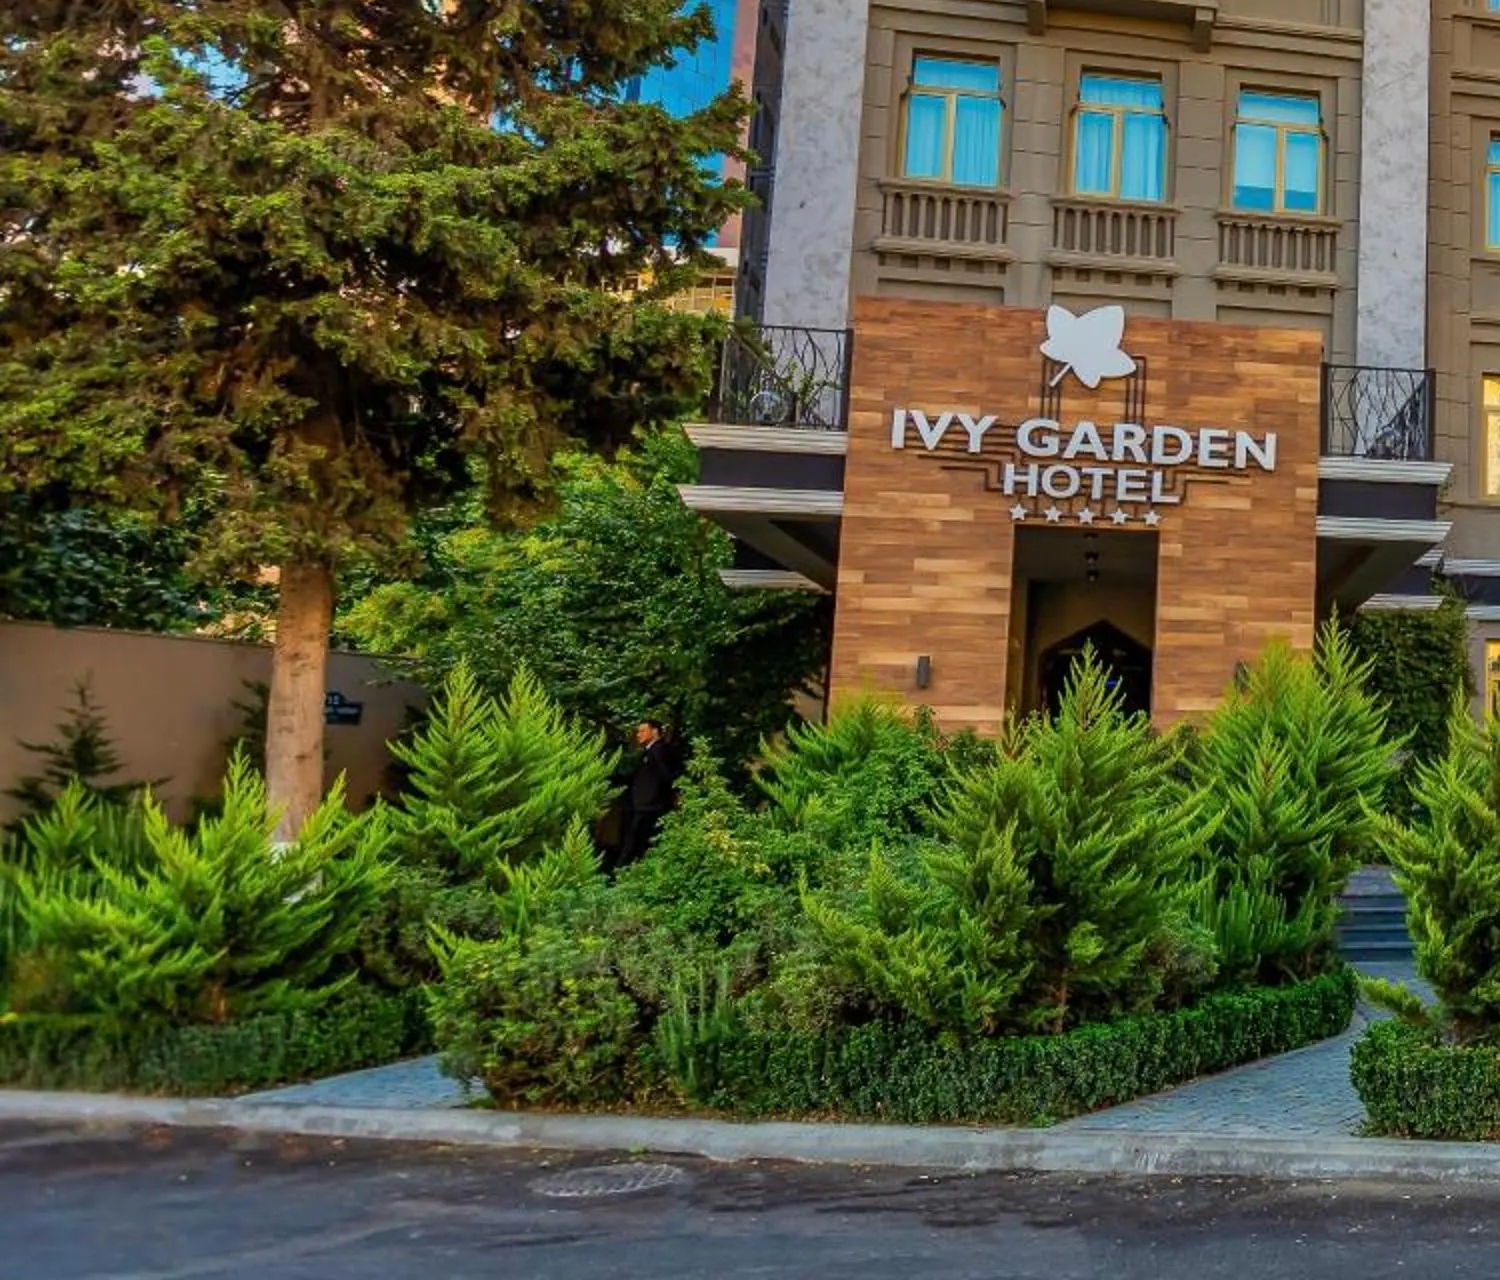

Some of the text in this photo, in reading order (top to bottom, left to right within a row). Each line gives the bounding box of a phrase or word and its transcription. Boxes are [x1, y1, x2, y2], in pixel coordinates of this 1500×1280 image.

[892, 409, 1277, 471] IVY GARDEN
[1003, 463, 1181, 504] HOTEL
